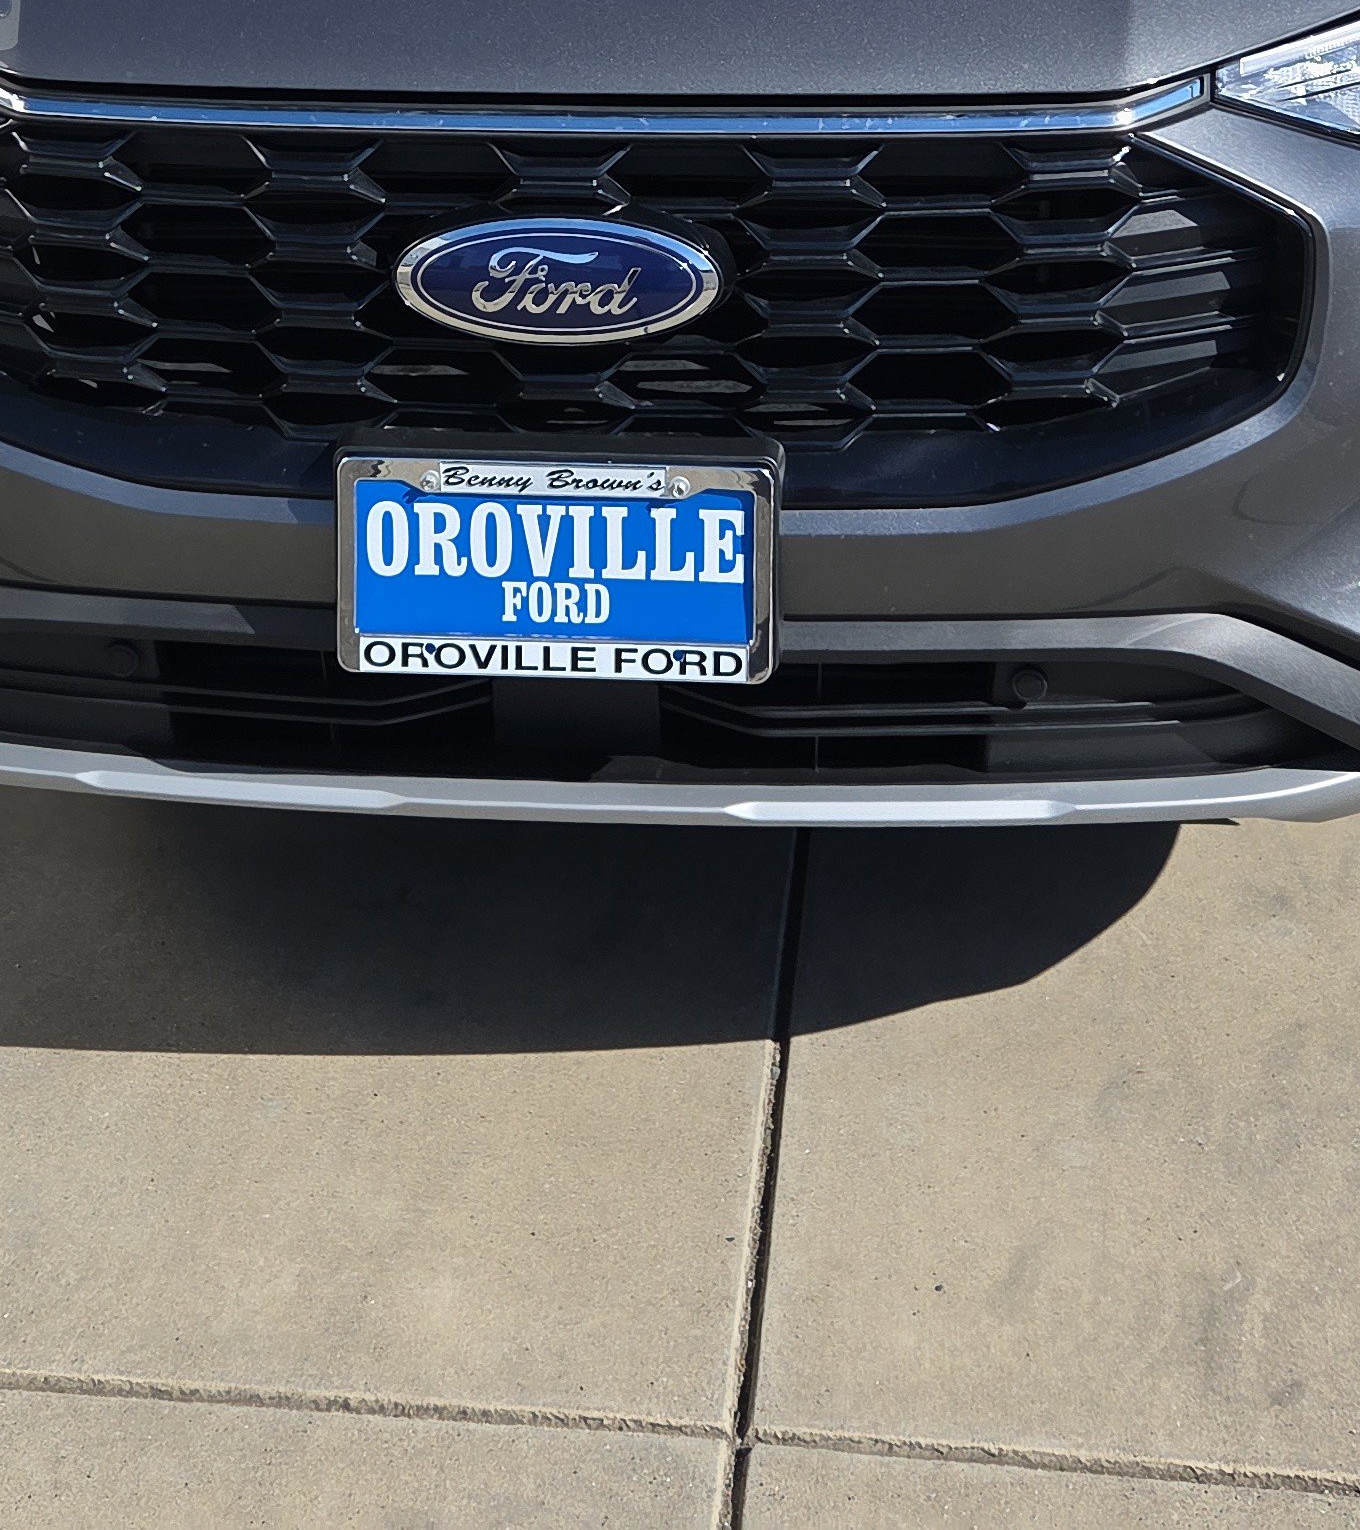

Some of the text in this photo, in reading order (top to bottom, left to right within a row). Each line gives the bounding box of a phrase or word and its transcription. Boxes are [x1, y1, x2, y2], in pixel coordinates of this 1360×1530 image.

[471, 246, 642, 316] Ford
[443, 466, 665, 493] Benny Brown's
[365, 500, 746, 585] OROVILLE
[501, 580, 611, 625] FORD
[363, 639, 744, 677] OROVILLE FORD
